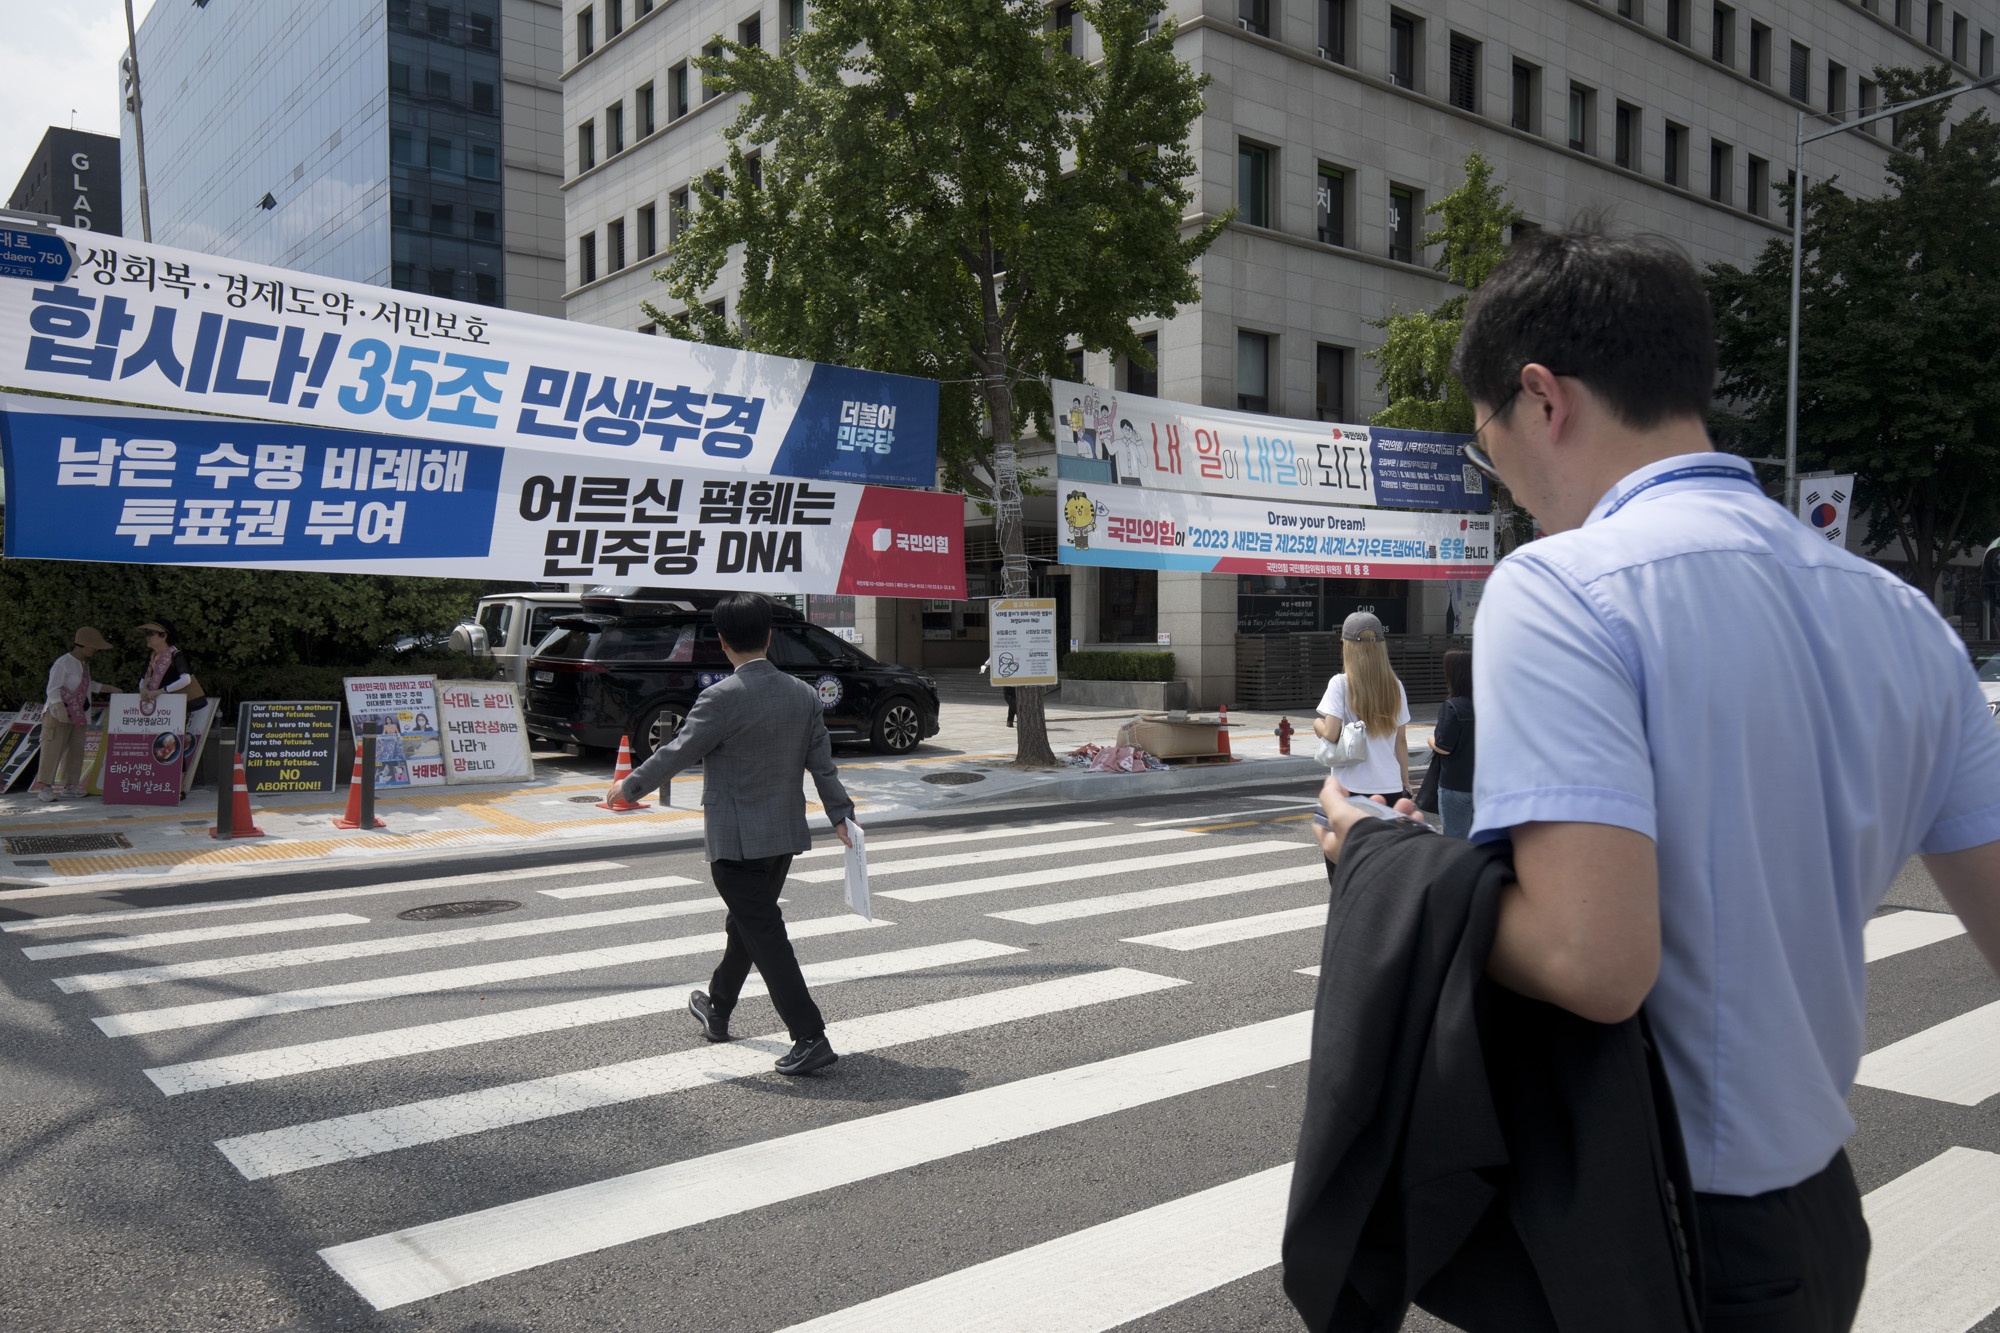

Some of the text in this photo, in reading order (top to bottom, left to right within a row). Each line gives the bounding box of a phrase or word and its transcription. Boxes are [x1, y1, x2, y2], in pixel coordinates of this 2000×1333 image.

[71, 152, 92, 231] GLAD
[1317, 187, 1331, 214] 치
[38, 251, 63, 265] 750
[24, 284, 766, 459] 합시다! 35조 민생추경
[840, 400, 897, 430] 더불어
[836, 425, 896, 454] 민주당
[1342, 430, 1368, 442] 국민의힘
[1377, 439, 1404, 452] 국민의힘
[1151, 422, 1368, 491] 내 일이 내일이 되다
[57, 437, 469, 492] 남은 수명 비례해
[519, 474, 836, 526] 어르신 폄훼는
[115, 498, 407, 546] 투표권 부여
[1268, 511, 1366, 532] Draw your Dream!
[1468, 521, 1490, 531] 국민의힘
[896, 533, 949, 554] 국민의힘
[1107, 516, 1185, 547] 국민의힘이
[1232, 530, 1273, 553] 새만금
[1275, 531, 1317, 555] 제25회
[1439, 538, 1489, 560] 응원합니다
[543, 528, 803, 577] 민주당 DNA
[1266, 562, 1288, 573] 국민의힘
[1289, 563, 1326, 574] 국민통합위원회
[1326, 565, 1342, 575] 위원장
[351, 680, 433, 692] 대한민국이 사라지고 있다
[365, 692, 378, 700] 가장
[394, 691, 408, 699] 인구
[443, 693, 480, 708] 낙태는
[483, 694, 514, 709] 살인!
[123, 707, 171, 717] with you
[122, 717, 171, 726] 태아생명살리기
[448, 721, 518, 734] 낙태찬성하면
[451, 739, 487, 753] 나라가
[110, 763, 155, 776] 태아생명,
[247, 759, 320, 767] kill the fetuses.
[453, 758, 495, 772] 망합니다
[279, 768, 300, 780] NO
[412, 764, 446, 778] 낙태반대
[121, 780, 176, 794] 함께 살려요.
[256, 781, 321, 791] ABORTION!!
